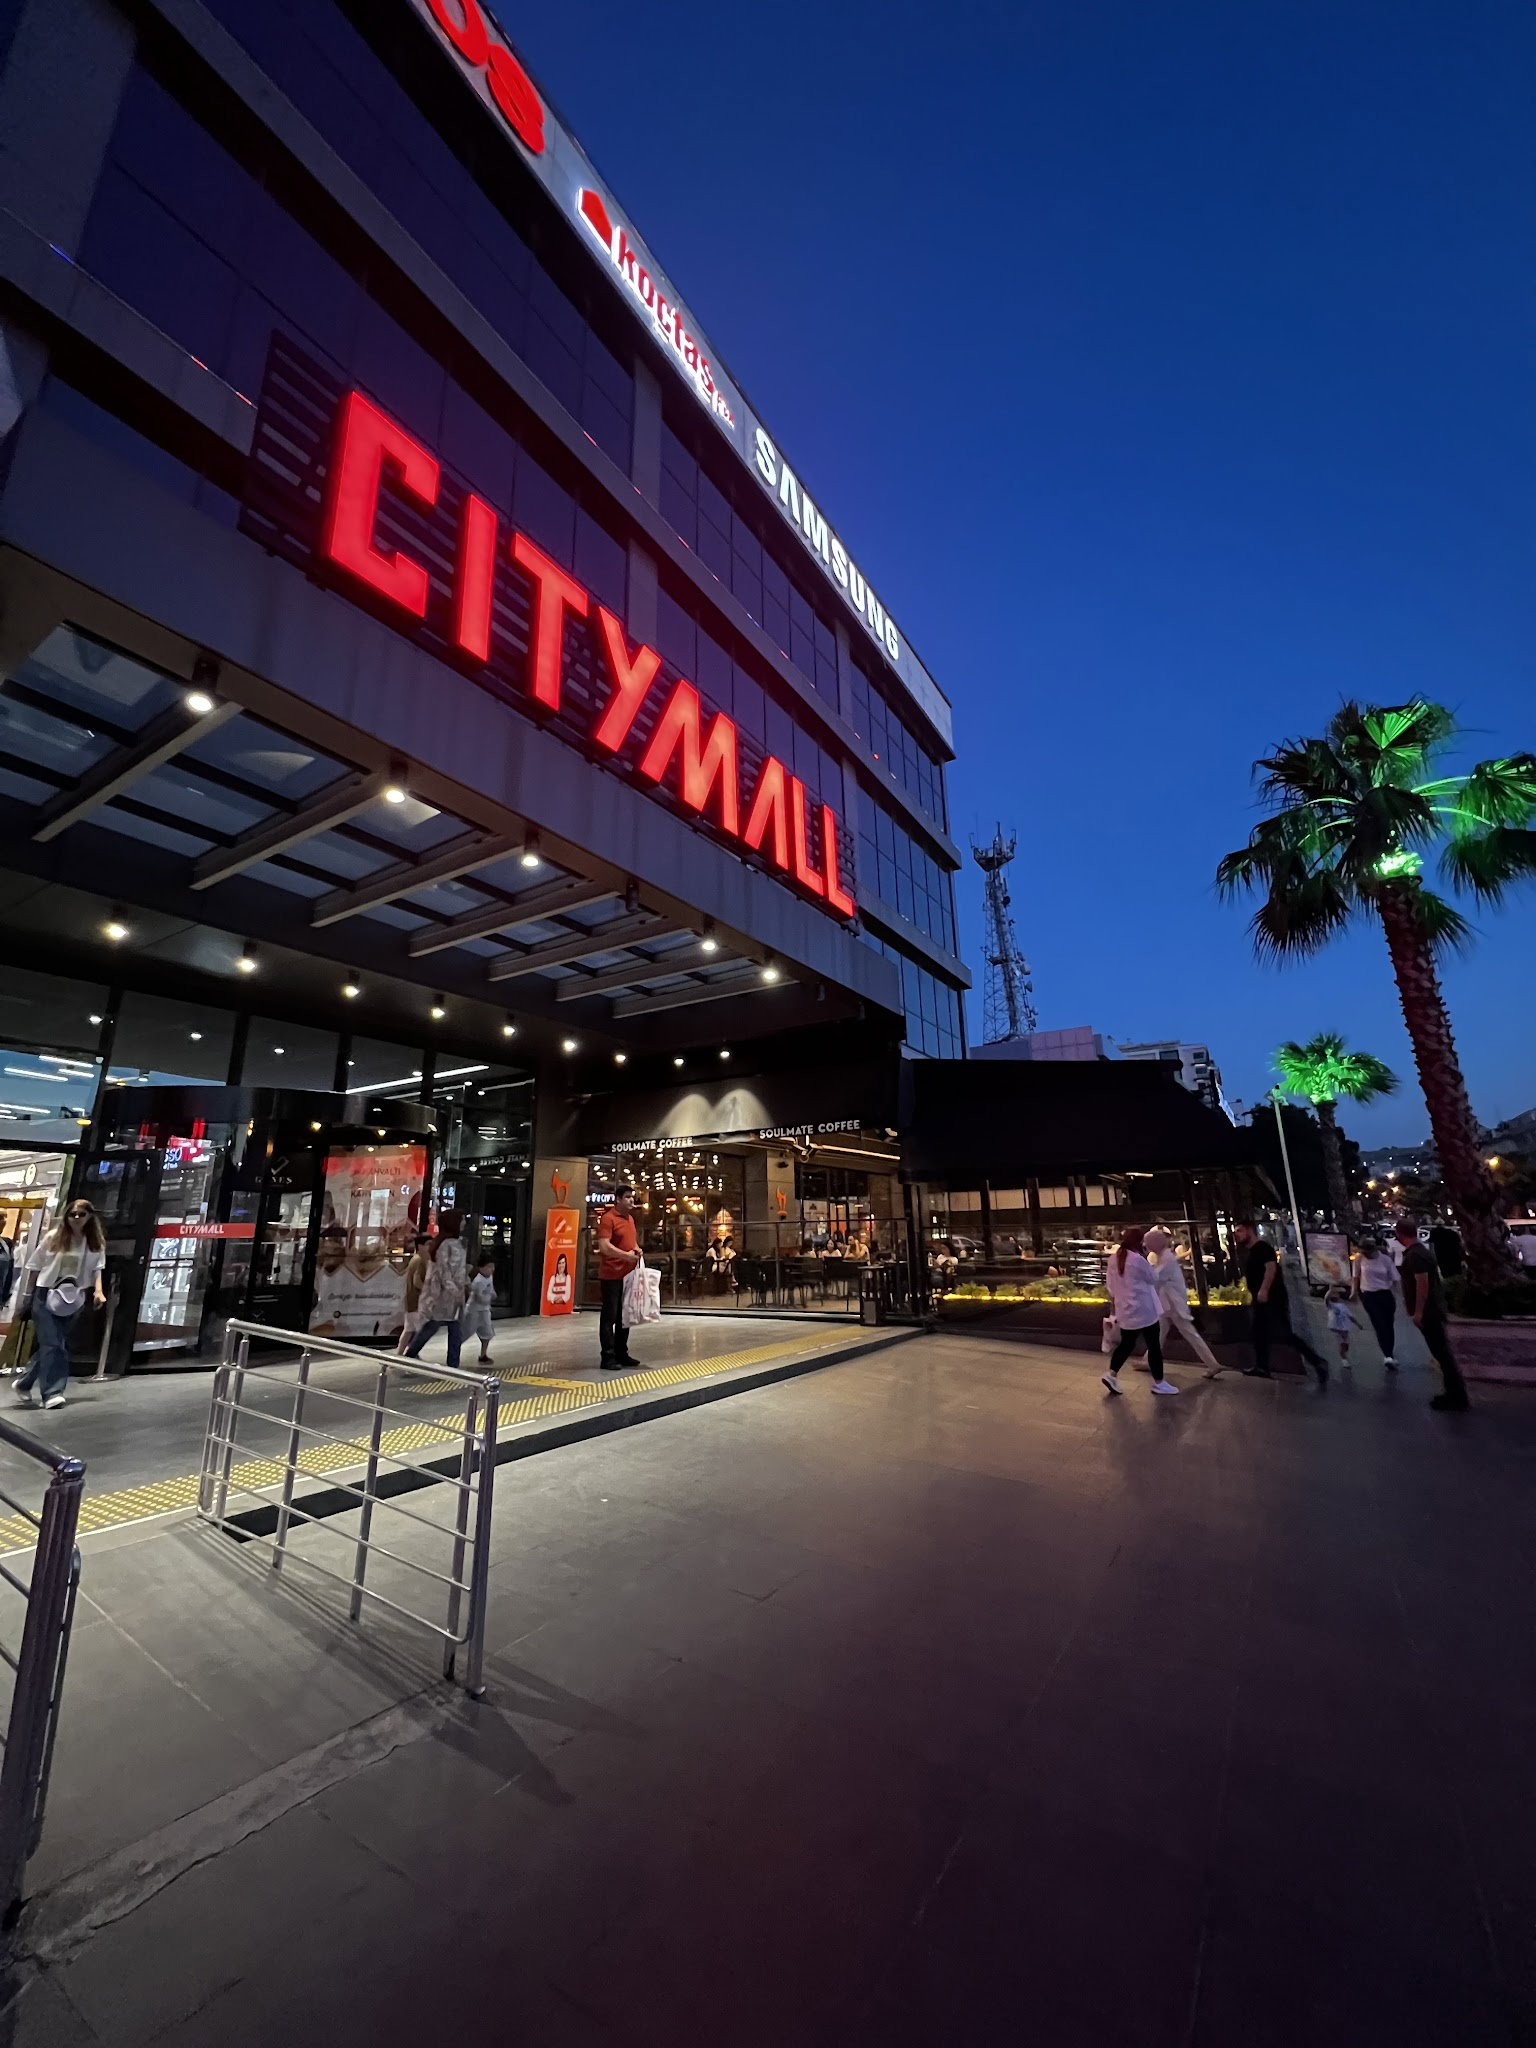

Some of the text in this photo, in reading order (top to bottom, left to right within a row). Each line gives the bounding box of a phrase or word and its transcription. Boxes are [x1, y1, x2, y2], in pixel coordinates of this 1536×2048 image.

[756, 427, 900, 662] SAMSUNG
[326, 389, 856, 920] CITYMALL
[759, 1120, 861, 1139] SOULMATE COFFEE
[611, 1137, 693, 1153] SOULMATE COFFEE
[179, 1225, 225, 1235] CITYMALL
